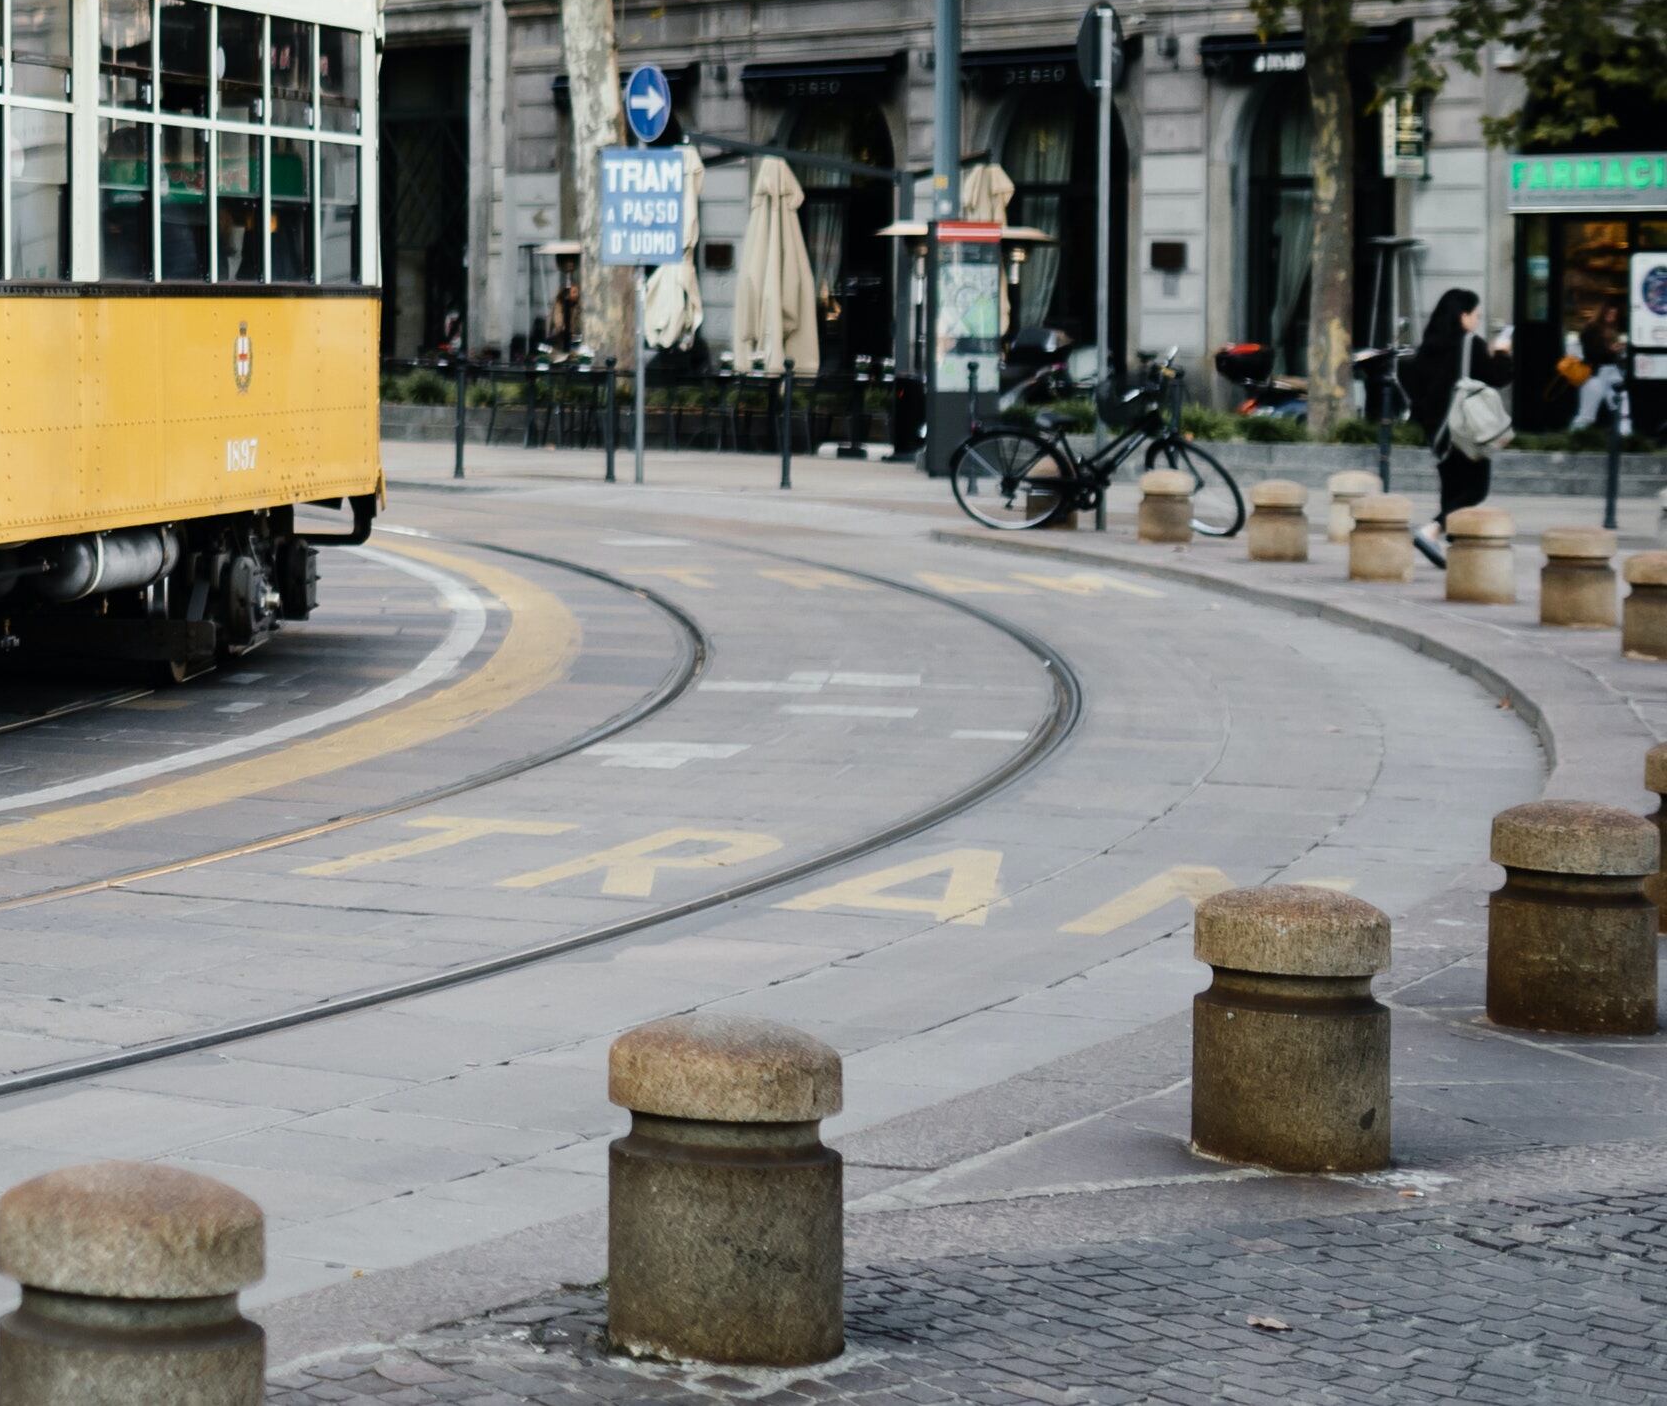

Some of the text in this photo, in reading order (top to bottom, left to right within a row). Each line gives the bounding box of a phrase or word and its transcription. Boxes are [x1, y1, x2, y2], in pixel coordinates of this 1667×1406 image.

[604, 159, 683, 193] TRAM
[622, 199, 679, 224] PASSO
[225, 437, 259, 473] 1897
